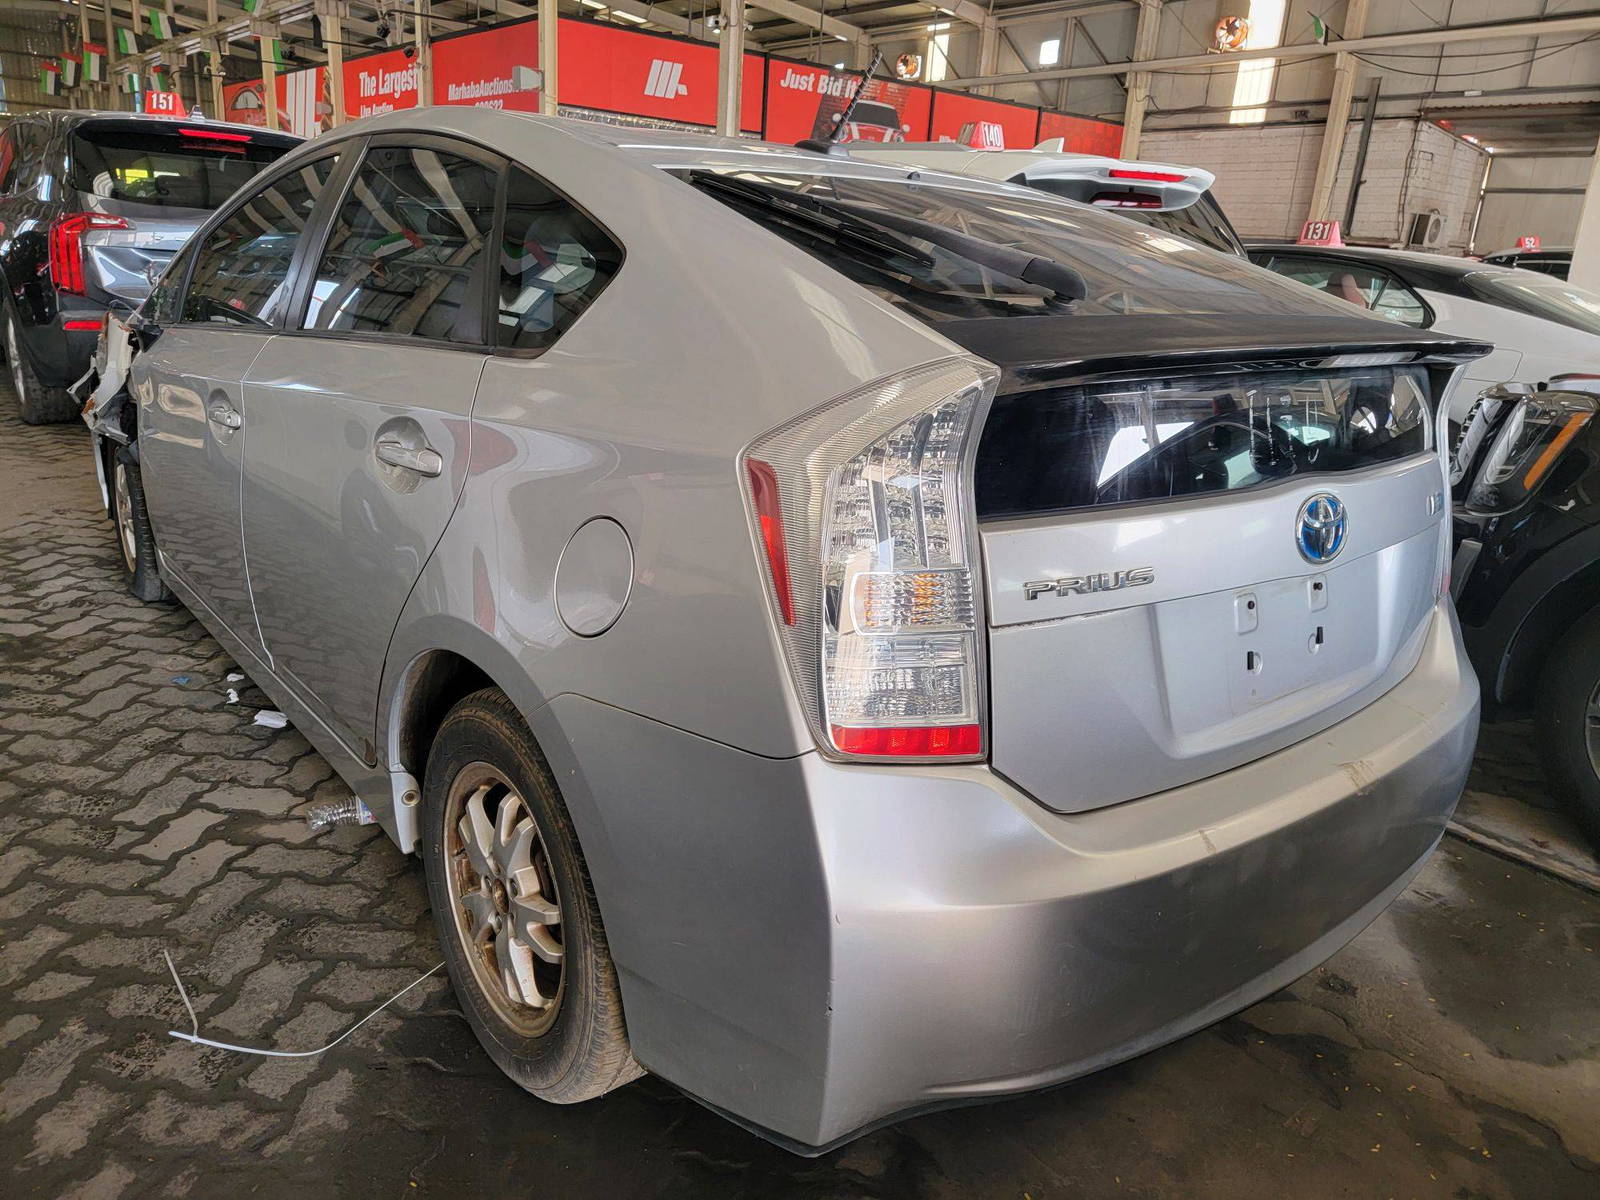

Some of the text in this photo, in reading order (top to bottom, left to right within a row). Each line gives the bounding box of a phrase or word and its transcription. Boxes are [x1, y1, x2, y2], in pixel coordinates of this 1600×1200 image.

[359, 67, 418, 98] The Largest
[780, 68, 815, 92] Just
[816, 74, 843, 97] Bid
[151, 93, 173, 111] 151
[983, 124, 1001, 147] 140
[1307, 222, 1330, 240] 131
[1525, 236, 1536, 249] 52
[1023, 566, 1155, 600] PRIUS
